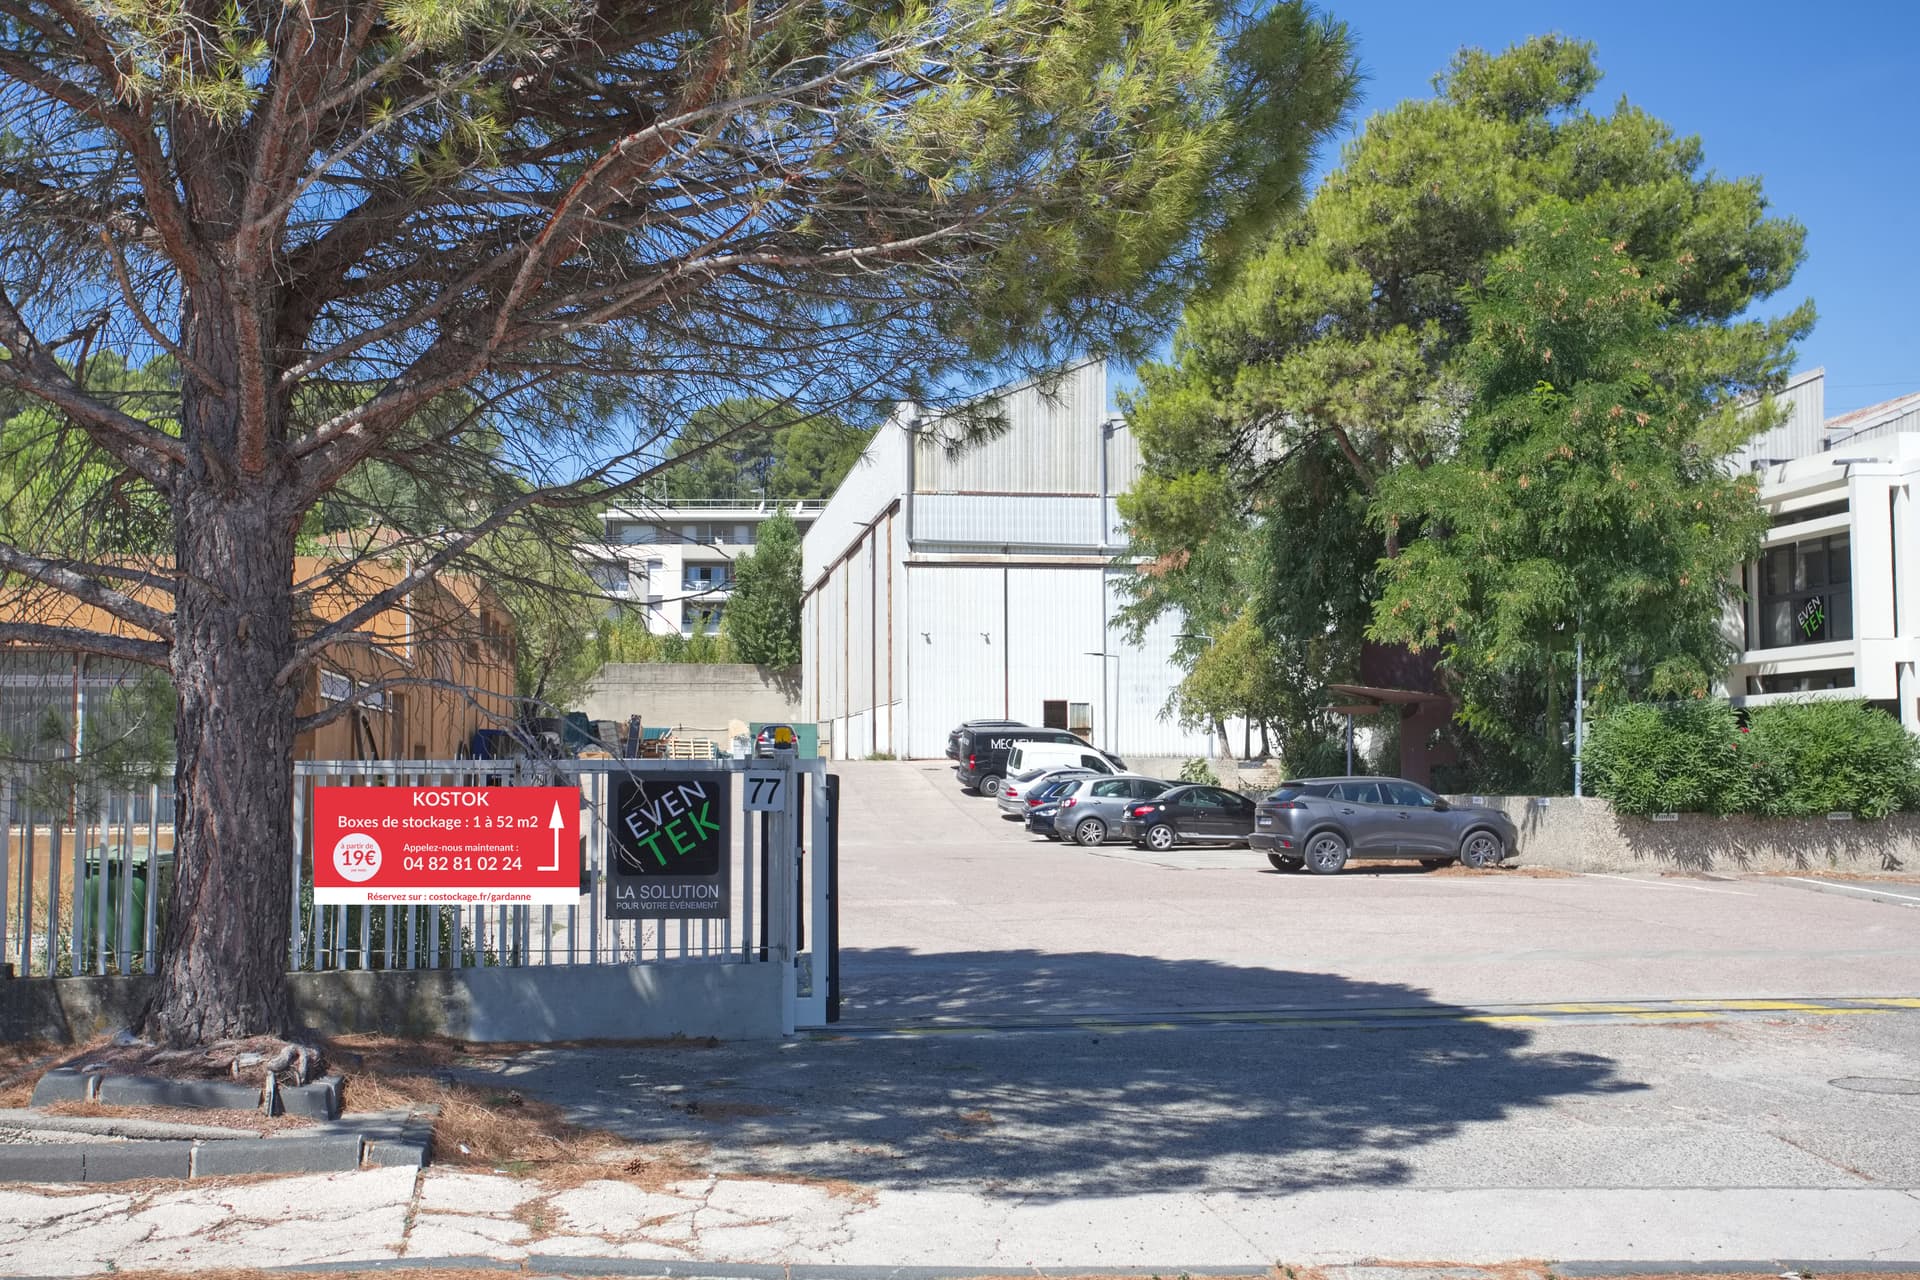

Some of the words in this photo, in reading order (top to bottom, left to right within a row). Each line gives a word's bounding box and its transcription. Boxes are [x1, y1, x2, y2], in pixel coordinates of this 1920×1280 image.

[1797, 595, 1821, 626] EVEN
[1802, 604, 1825, 637] TEK
[413, 791, 489, 807] KOSTOK
[749, 777, 781, 805] 77
[625, 780, 707, 839] EVEN
[338, 815, 379, 828] Boxes
[382, 815, 399, 828] de
[402, 815, 462, 831] stockage
[473, 815, 481, 828] 1
[485, 814, 493, 828] à
[496, 815, 514, 828] 52
[517, 815, 538, 828] m2
[637, 800, 720, 866] TEK
[346, 842, 364, 850] partir
[404, 843, 462, 854] Appelez-nous
[464, 843, 514, 852] maintenant
[342, 850, 376, 866] 19€
[403, 856, 424, 871] 04
[428, 856, 449, 871] 82
[452, 856, 472, 871] 81
[477, 856, 498, 871] 02
[502, 856, 523, 871] 24
[367, 892, 407, 901] Réservez
[428, 892, 532, 903] costockage.fr/gardanne
[616, 885, 635, 899] LA
[639, 884, 719, 899] SOLUTION
[616, 902, 639, 910] POUR
[640, 902, 668, 910] VOTRE
